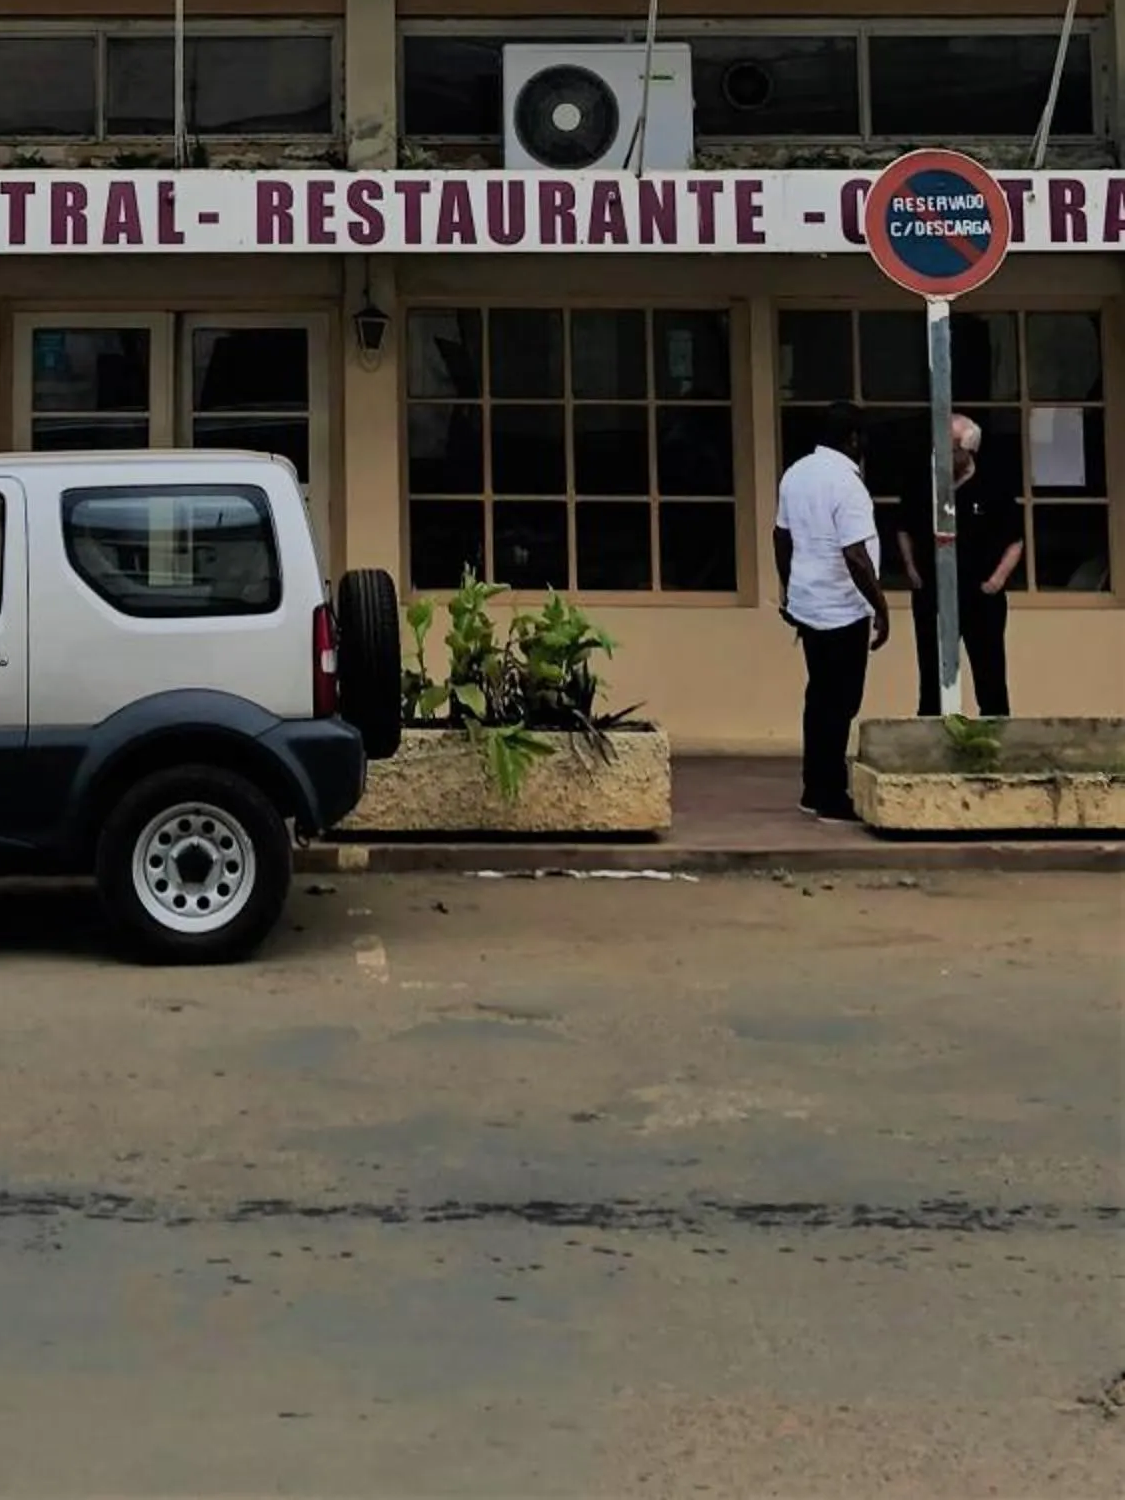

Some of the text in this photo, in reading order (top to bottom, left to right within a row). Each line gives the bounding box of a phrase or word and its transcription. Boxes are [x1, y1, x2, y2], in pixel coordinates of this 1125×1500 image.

[256, 180, 766, 245] RESTAURANTE
[892, 194, 985, 213] RESERVADO
[890, 219, 992, 237] C/DESCARGA
